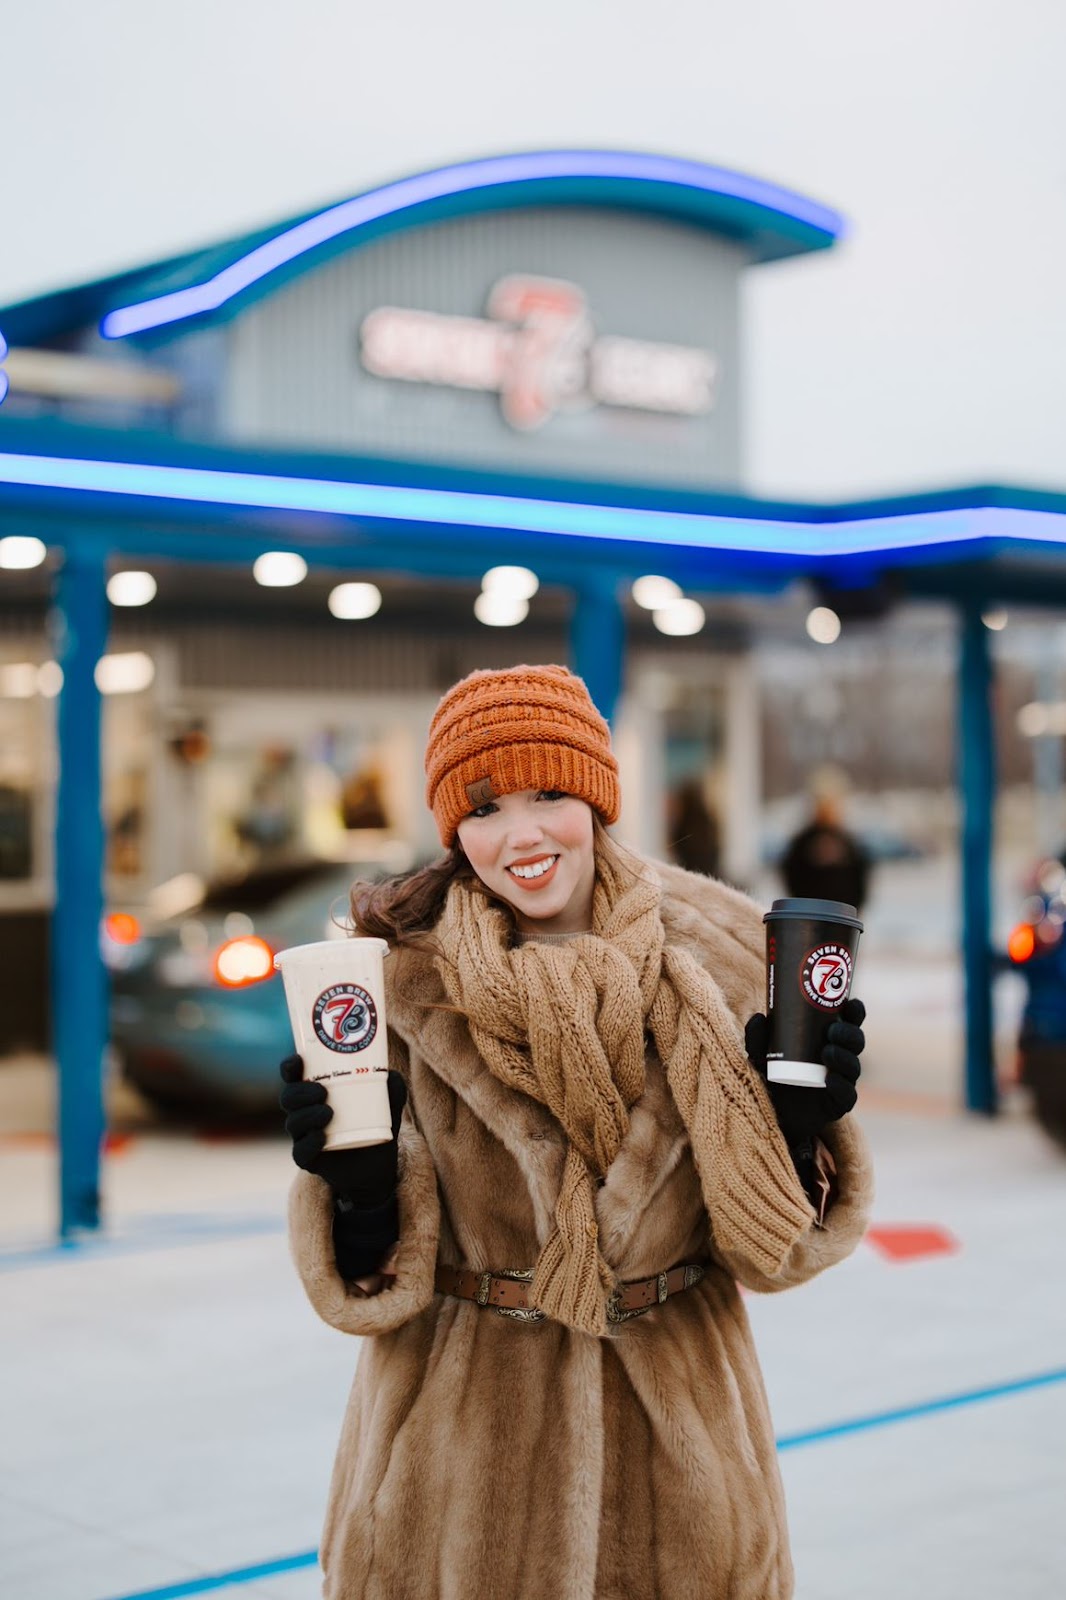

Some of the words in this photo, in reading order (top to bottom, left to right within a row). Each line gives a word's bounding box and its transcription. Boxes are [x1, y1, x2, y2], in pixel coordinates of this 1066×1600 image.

[807, 946, 837, 965] SEVEN
[315, 986, 344, 1012] SEVEN
[346, 985, 373, 1006] BREW
[803, 980, 819, 1001] DRIVE
[817, 998, 834, 1008] THRU
[318, 1029, 336, 1049] DRIVE
[337, 1043, 358, 1052] THRU
[359, 1024, 376, 1049] COFFEE
